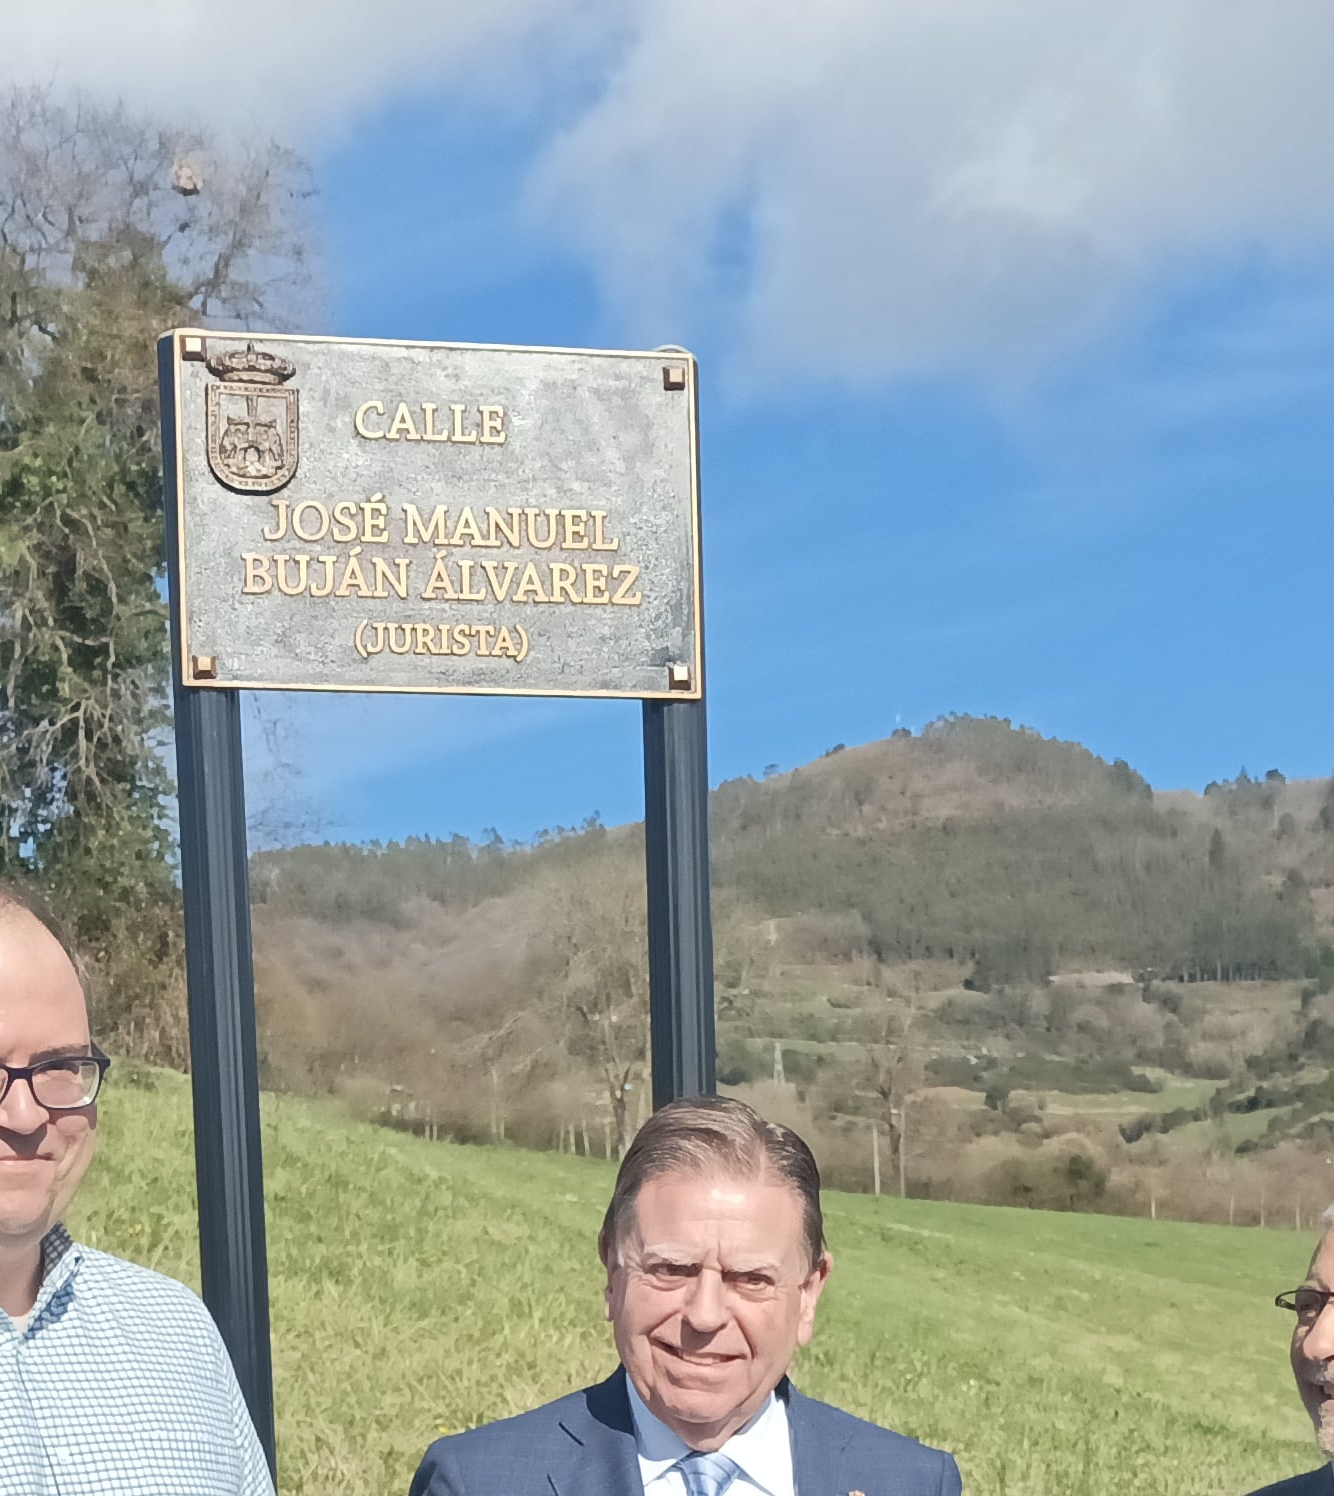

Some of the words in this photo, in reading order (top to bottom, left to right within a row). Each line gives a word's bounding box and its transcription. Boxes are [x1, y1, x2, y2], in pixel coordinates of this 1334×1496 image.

[354, 400, 507, 445] CALLE
[262, 493, 390, 544] JOSÉ
[402, 503, 620, 551] MANUEL
[241, 549, 411, 599] BUJÁN
[425, 550, 642, 606] ÁLVAREZ
[354, 620, 530, 663] (JURISTA)
